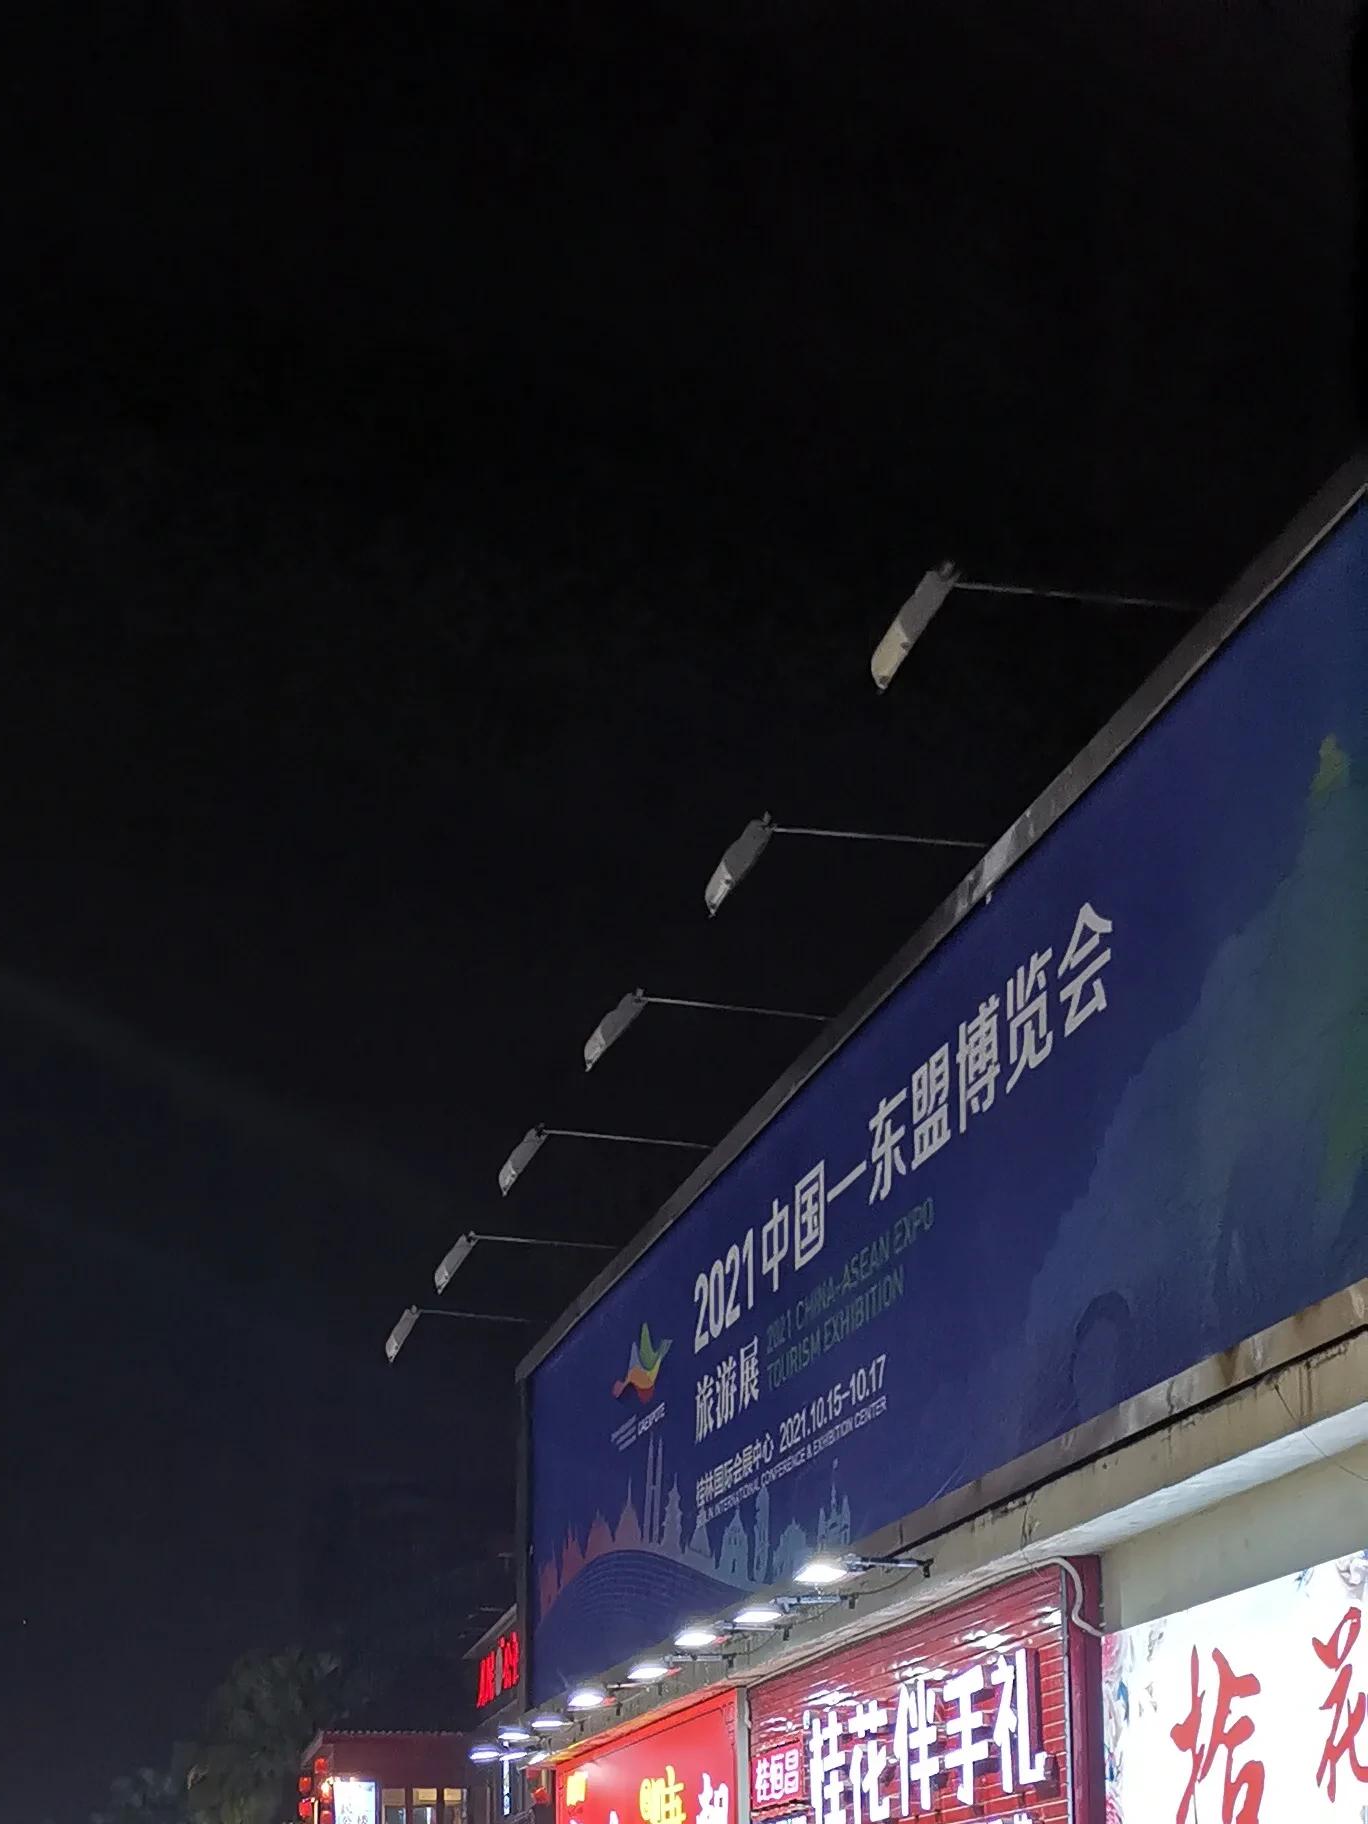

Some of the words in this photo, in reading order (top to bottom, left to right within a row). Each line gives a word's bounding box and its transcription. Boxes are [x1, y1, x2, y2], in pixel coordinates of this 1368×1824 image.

[893, 1197, 934, 1260] EXPO
[767, 1330, 822, 1391] TOURISM
[823, 1265, 905, 1351] EXHIBITION
[695, 1335, 760, 1445] 旅游展
[854, 1395, 888, 1432] CENTER
